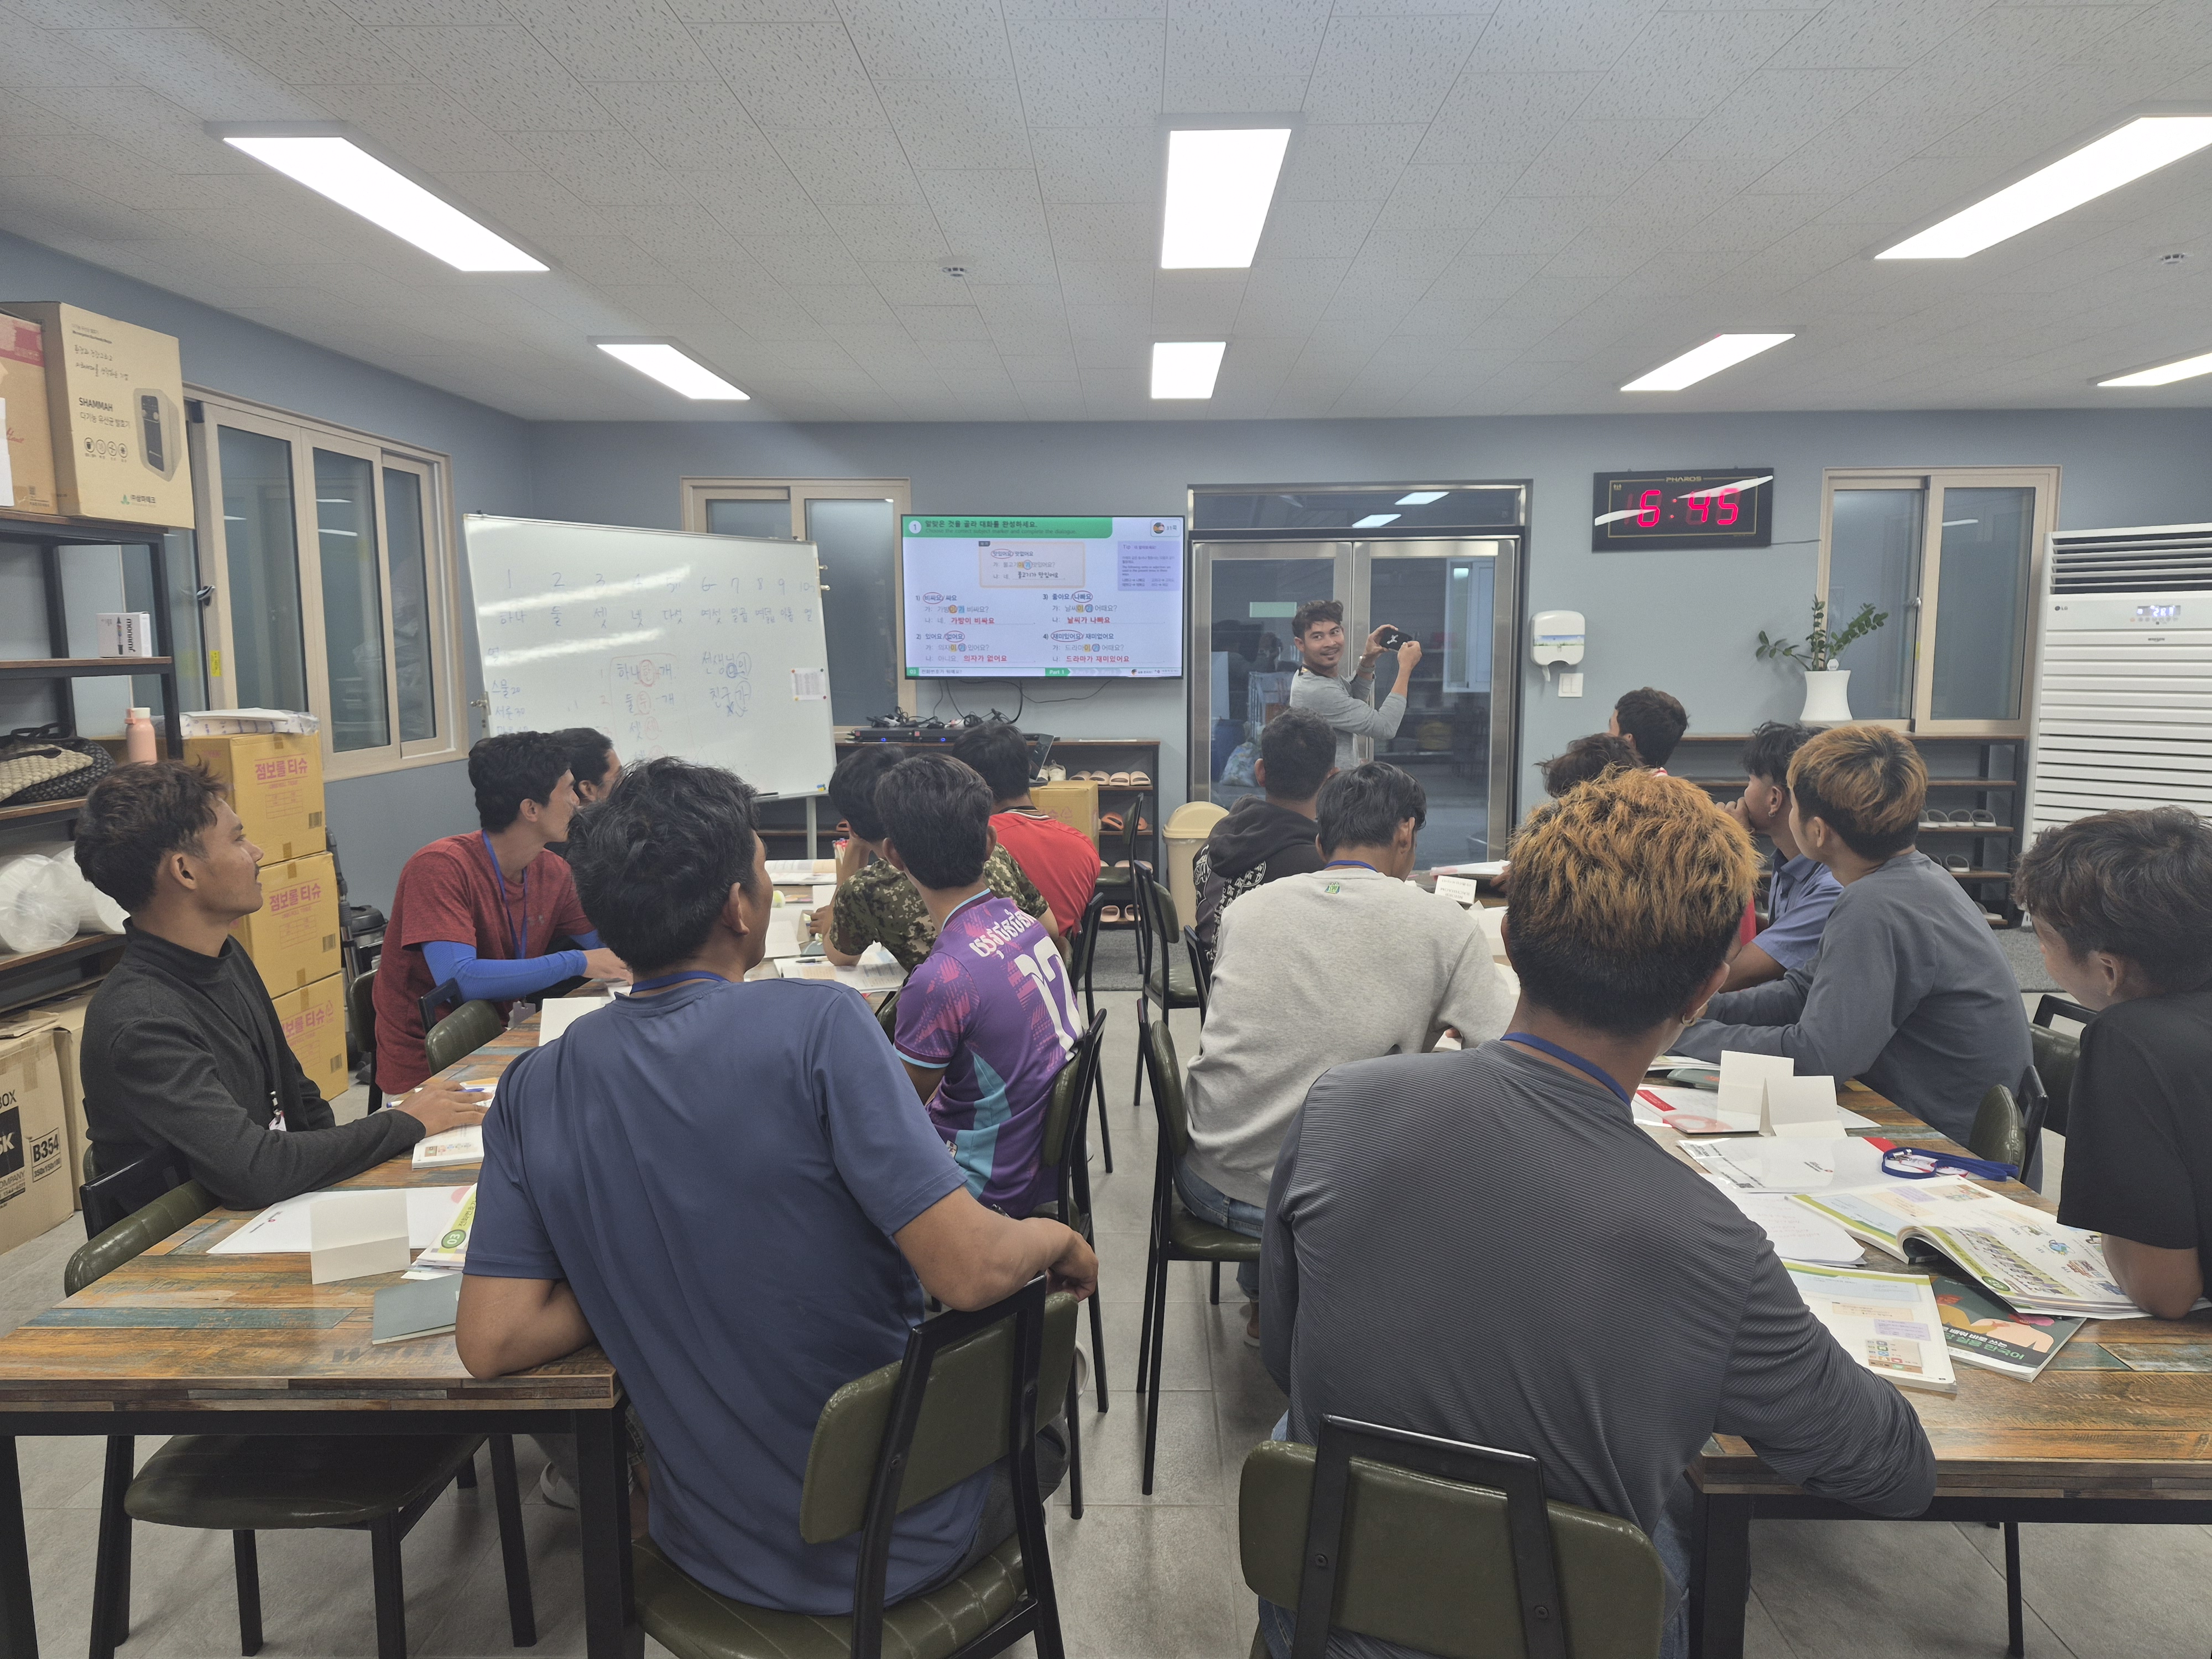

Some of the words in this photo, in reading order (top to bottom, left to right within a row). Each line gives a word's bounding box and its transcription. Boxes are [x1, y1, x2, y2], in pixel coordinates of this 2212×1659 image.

[79, 397, 113, 411] SHAMMAH
[1637, 488, 1740, 527] 6:45
[552, 572, 564, 586] 2
[731, 577, 739, 593] 7
[758, 578, 763, 590] 8
[779, 579, 785, 595] 9
[500, 611, 525, 624] 하나
[551, 606, 562, 626] 둘
[594, 606, 607, 628] 셋
[632, 609, 644, 627] 넷
[663, 609, 682, 624] 다섯
[701, 608, 721, 624] 여섯
[732, 608, 748, 623] 일곱
[805, 608, 812, 622] 열
[492, 679, 509, 698] 스물
[255, 760, 286, 781] 점보롤
[287, 758, 308, 774] 티슈
[269, 888, 299, 912] 점보롤
[300, 884, 321, 901] 티슈
[306, 1010, 325, 1027] 티슈
[33, 1134, 59, 1163] B354
[0, 1170, 25, 1189] OMPANY
[447, 1234, 460, 1244] 03
[1988, 1276, 2004, 1290] 03
[1969, 1334, 1988, 1342] 바로
[1988, 1339, 2007, 1348] 쓰는
[1984, 1344, 2025, 1360] 한국어
